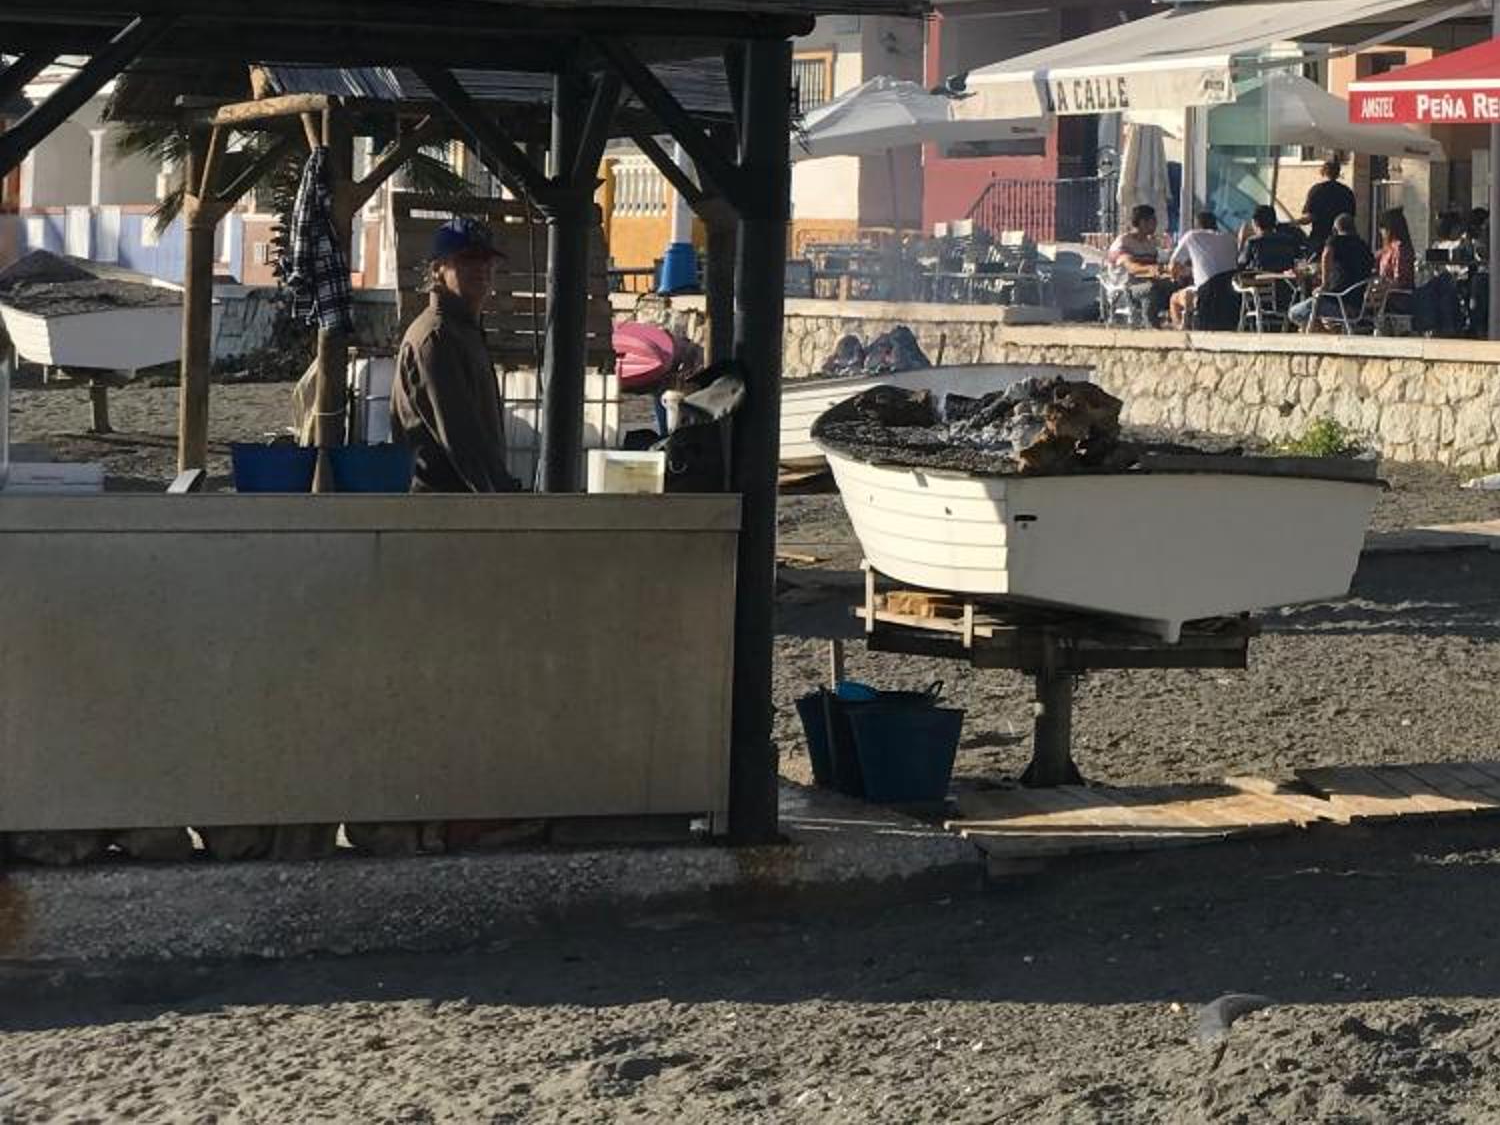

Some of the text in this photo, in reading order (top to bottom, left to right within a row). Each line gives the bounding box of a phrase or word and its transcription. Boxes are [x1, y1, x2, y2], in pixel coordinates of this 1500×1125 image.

[1047, 77, 1130, 112] LA CALLE
[1361, 95, 1395, 119] AMSTEL
[1416, 92, 1468, 120] PEÑA
